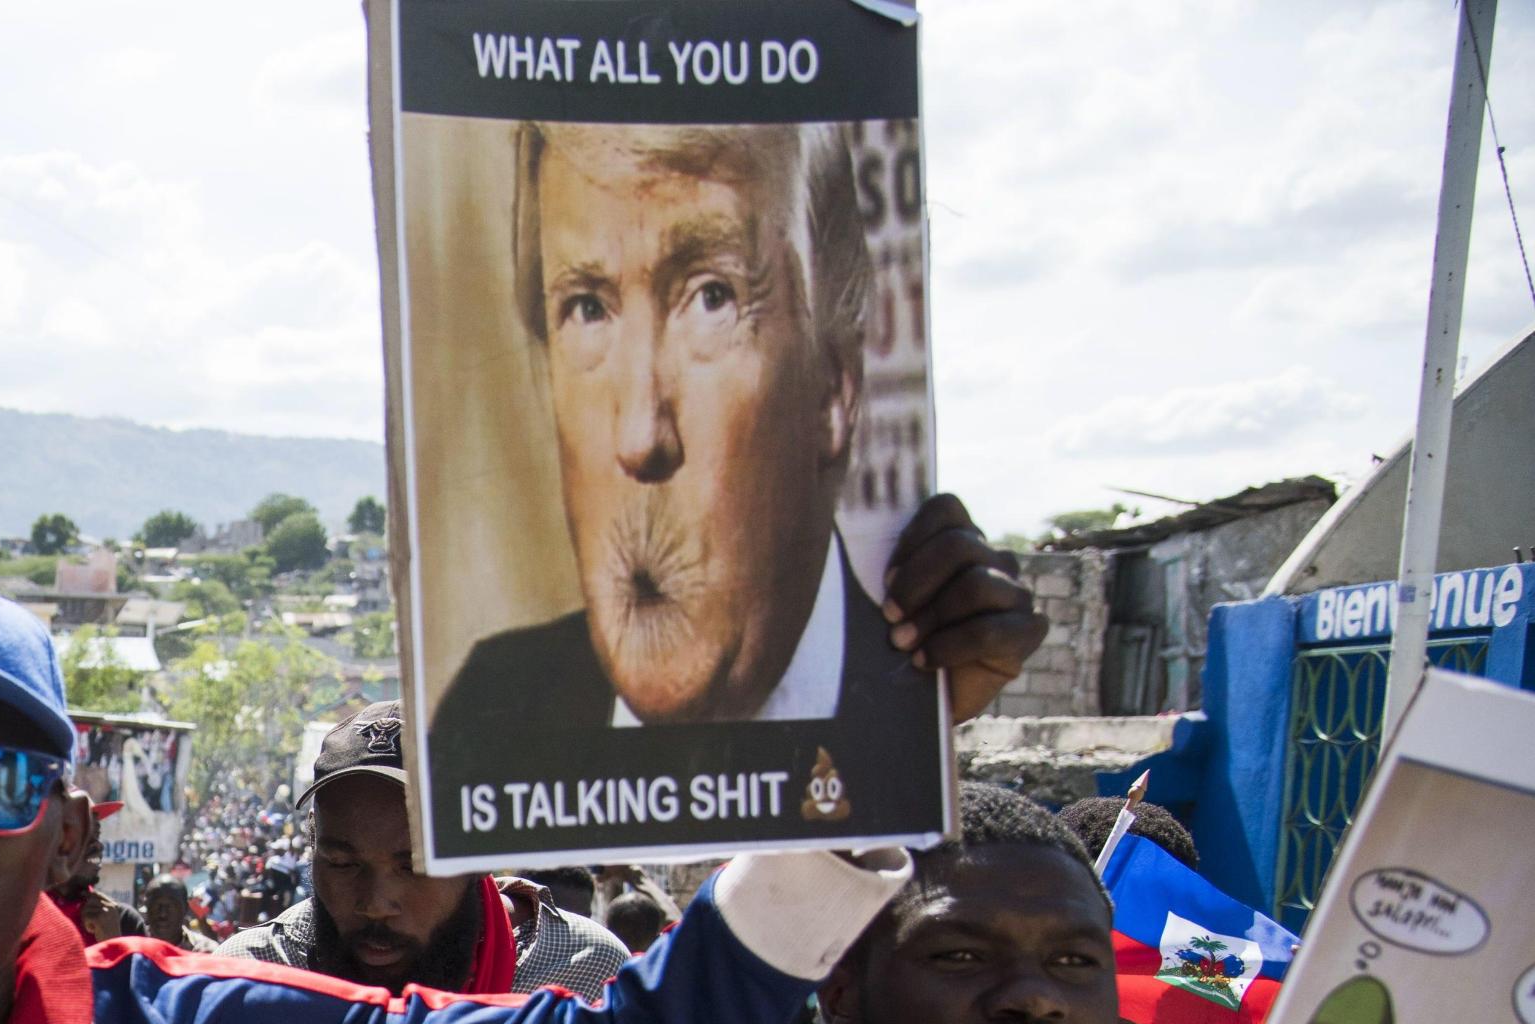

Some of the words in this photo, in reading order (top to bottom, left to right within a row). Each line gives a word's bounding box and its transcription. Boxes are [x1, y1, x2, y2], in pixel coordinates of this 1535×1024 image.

[472, 31, 581, 83] WHAT
[589, 38, 662, 84] ALL
[667, 39, 750, 85] YOU
[760, 38, 820, 84] DO
[461, 784, 498, 833] IS
[503, 777, 681, 830] TALKING
[690, 771, 789, 821] SHIT
